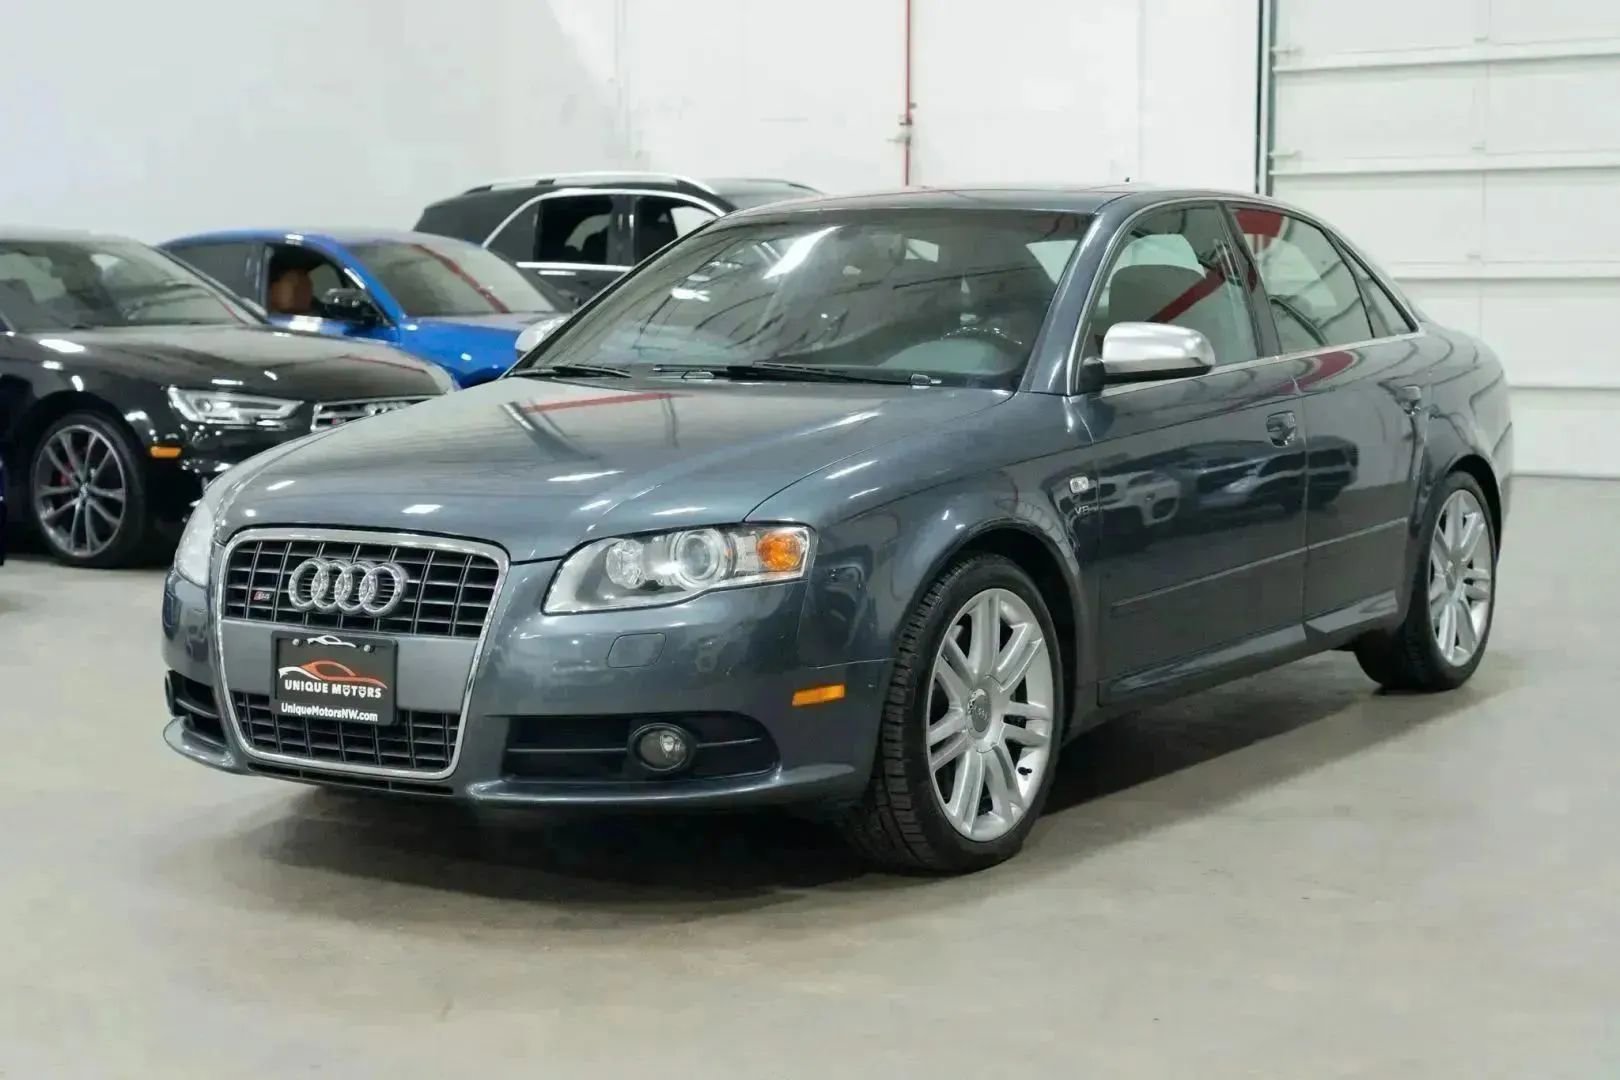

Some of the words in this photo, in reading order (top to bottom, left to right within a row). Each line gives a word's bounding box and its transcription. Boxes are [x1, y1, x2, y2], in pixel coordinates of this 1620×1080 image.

[284, 680, 329, 694] UNIQUE
[331, 684, 382, 699] MOTORS
[281, 702, 378, 722] UniqueMotorsNW.com
